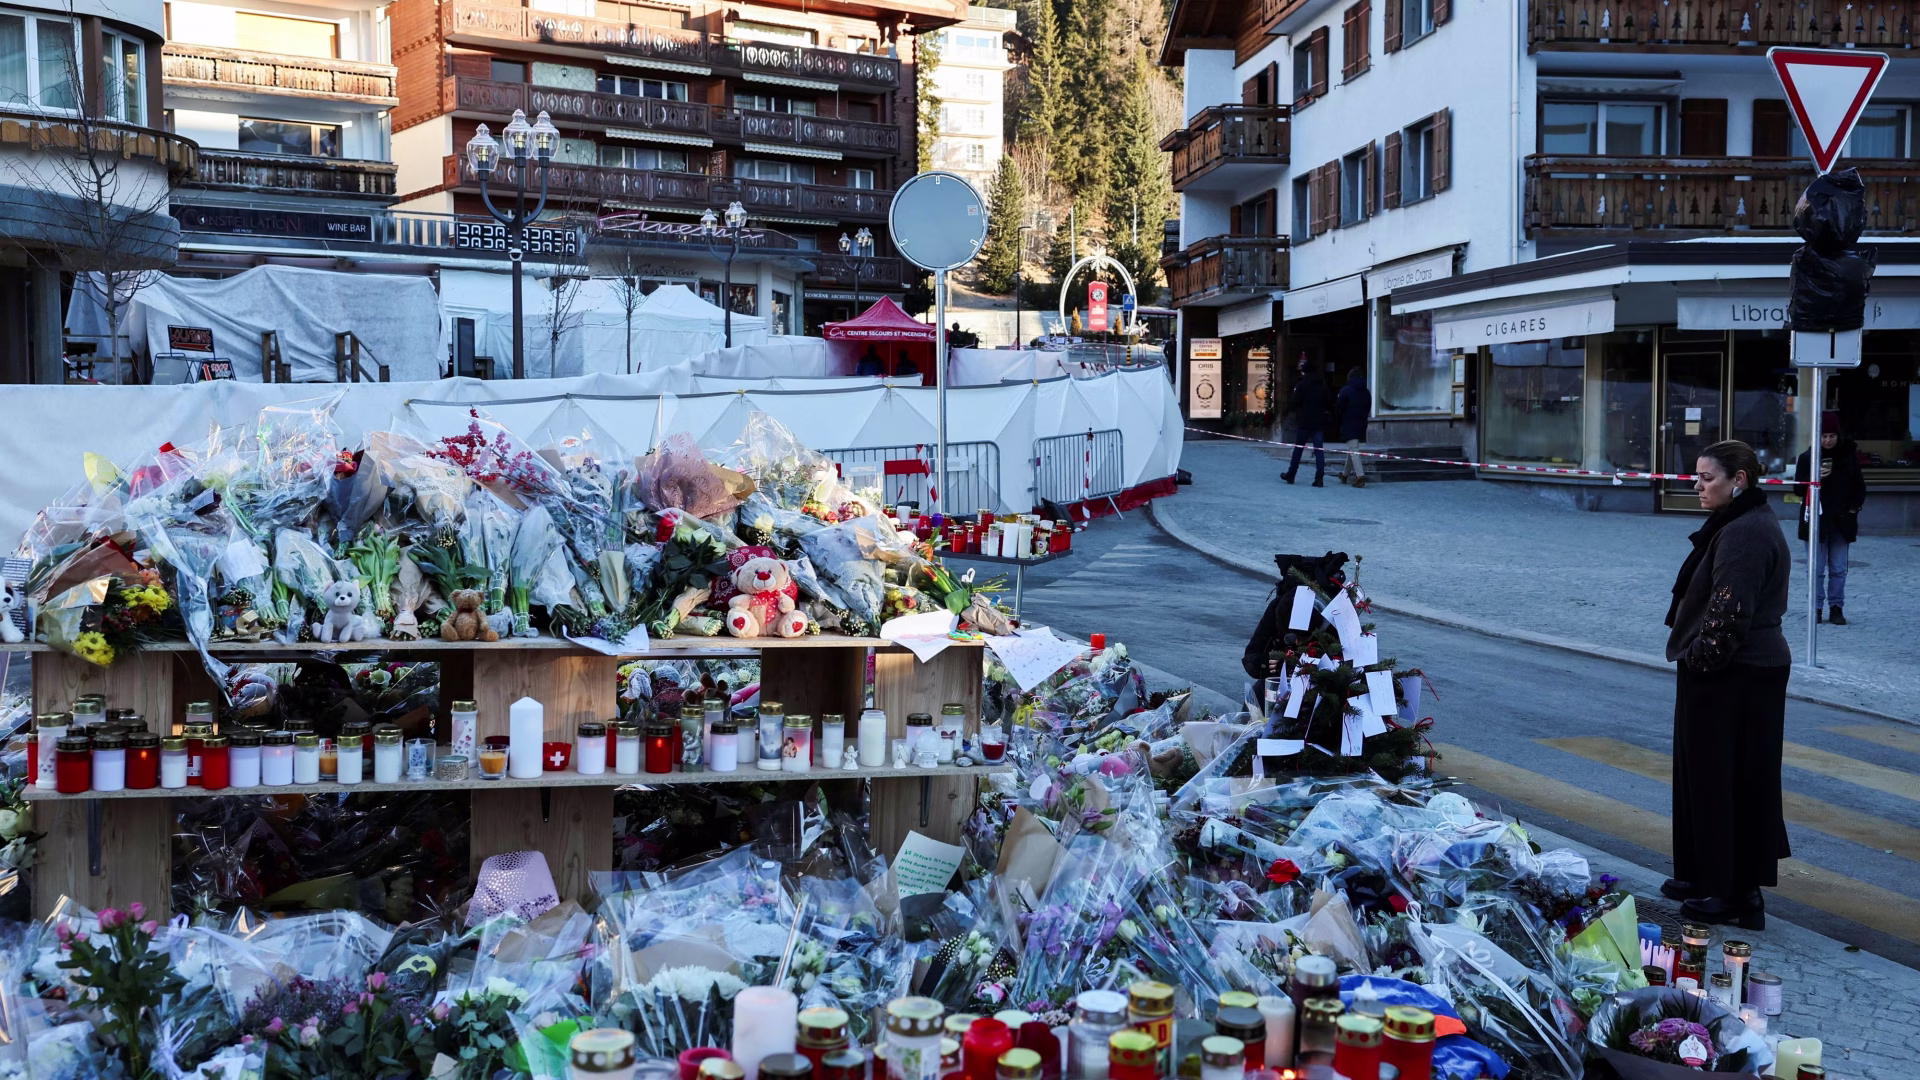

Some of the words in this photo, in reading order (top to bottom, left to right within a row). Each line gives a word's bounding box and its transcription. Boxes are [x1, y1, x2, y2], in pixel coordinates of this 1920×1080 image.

[327, 222, 348, 232] WINE
[350, 224, 366, 233] BAR
[1383, 275, 1405, 290] Librairie
[1406, 272, 1414, 285] de
[1414, 268, 1432, 283] Crans
[1731, 304, 1790, 321] Librai
[1485, 317, 1546, 337] CIGARES
